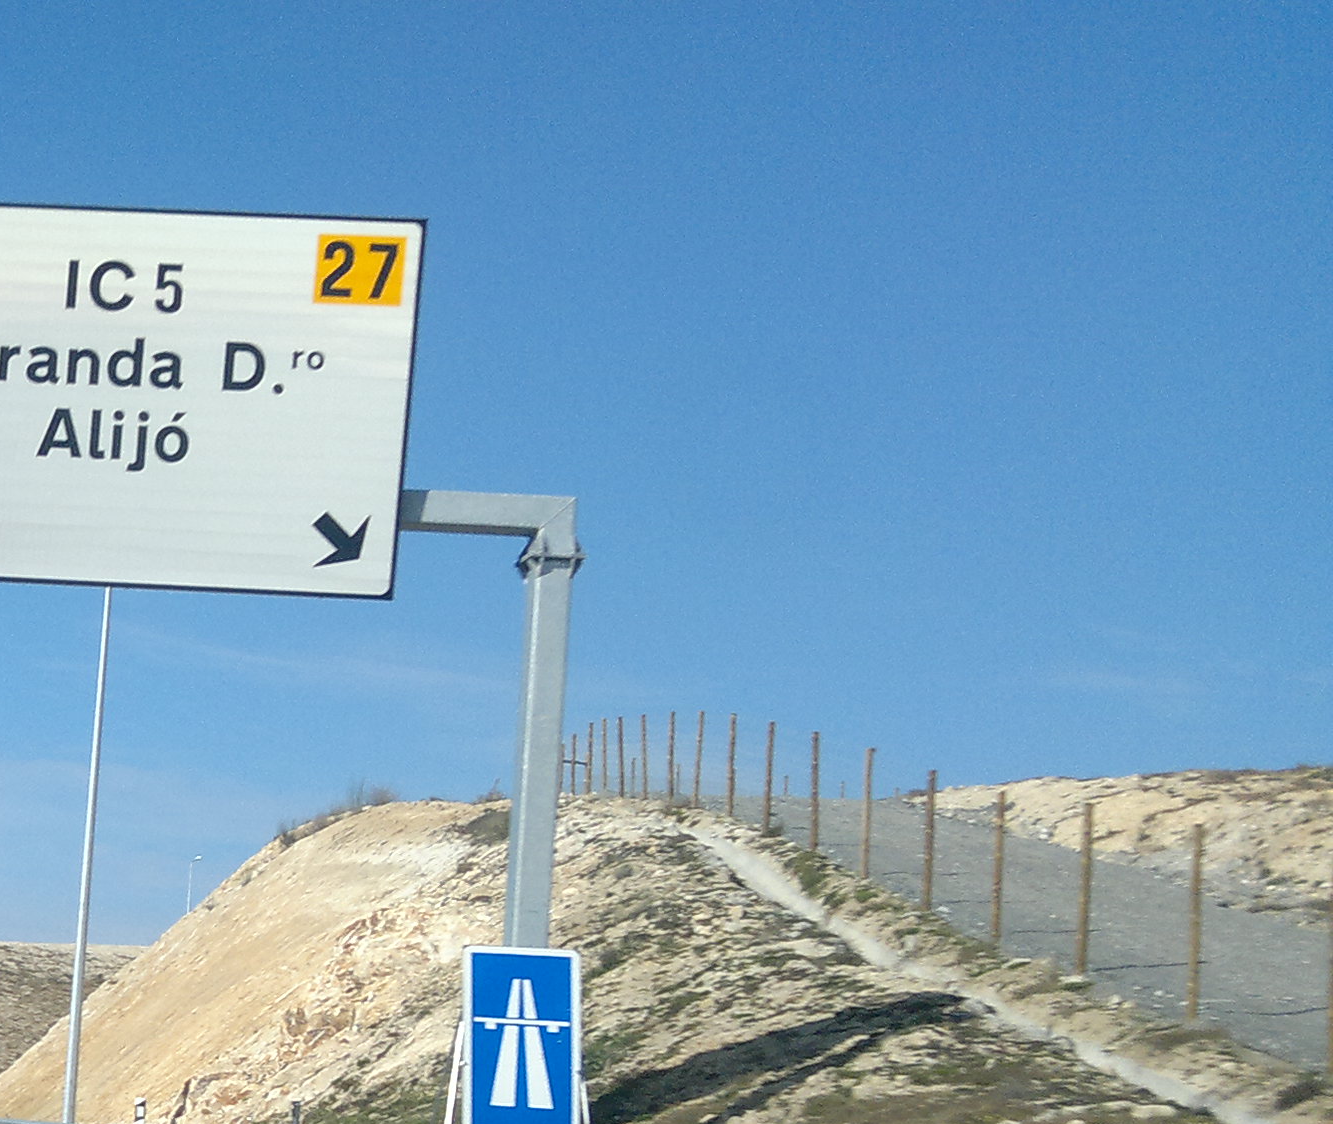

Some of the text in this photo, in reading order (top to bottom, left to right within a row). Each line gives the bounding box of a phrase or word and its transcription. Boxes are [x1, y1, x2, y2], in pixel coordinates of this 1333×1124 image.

[65, 260, 183, 314] IC 5
[320, 240, 399, 299] 27
[36, 408, 189, 472] Alijó
